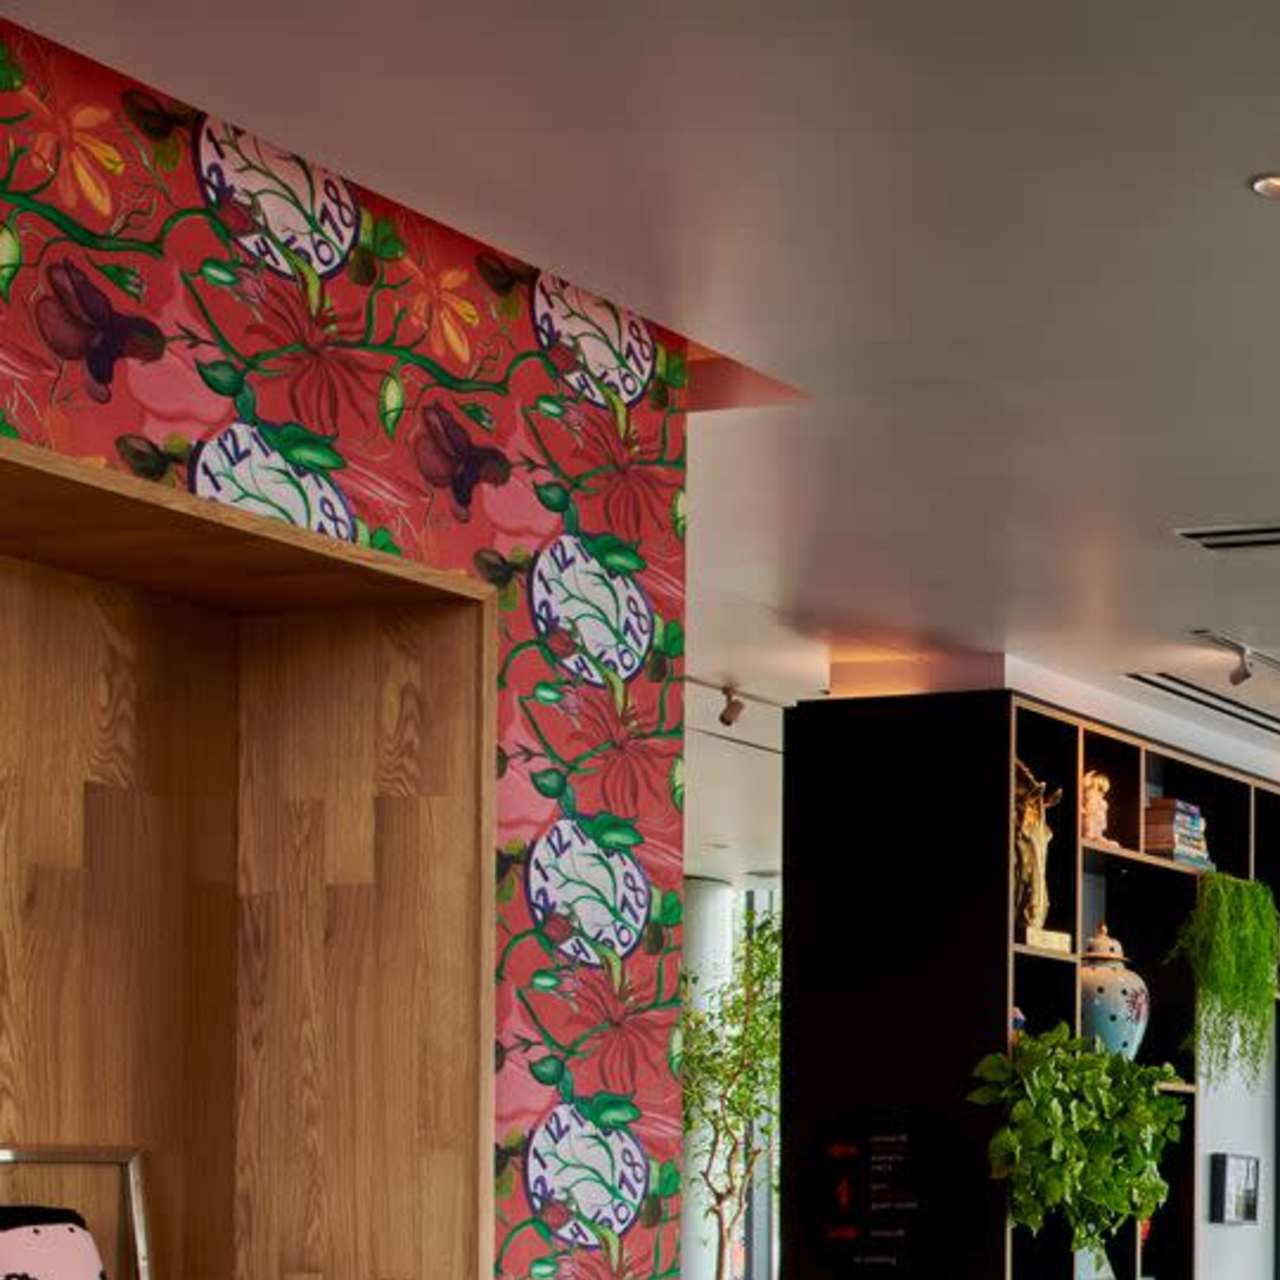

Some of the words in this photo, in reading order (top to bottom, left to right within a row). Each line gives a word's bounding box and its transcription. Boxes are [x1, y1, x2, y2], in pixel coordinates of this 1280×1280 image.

[324, 178, 354, 228] 8
[319, 203, 344, 245] 7
[254, 236, 280, 266] 4
[309, 233, 335, 265] 6
[628, 319, 651, 361] 8
[625, 341, 645, 376] 7
[575, 373, 596, 399] 4
[618, 368, 638, 396] 6
[217, 427, 252, 467] 12
[549, 540, 576, 573] 12
[626, 596, 649, 635] 8
[623, 617, 643, 649] 7
[574, 655, 595, 679] 4
[616, 645, 635, 671] 6
[546, 825, 572, 858] 12
[623, 871, 648, 909] 8
[619, 893, 640, 924] 7
[570, 938, 592, 961] 4
[611, 920, 633, 947] 6
[545, 1111, 571, 1144] 12
[621, 1147, 644, 1184] 8
[618, 1169, 638, 1200] 7
[611, 1198, 631, 1225] 6
[568, 1220, 589, 1242] 4
